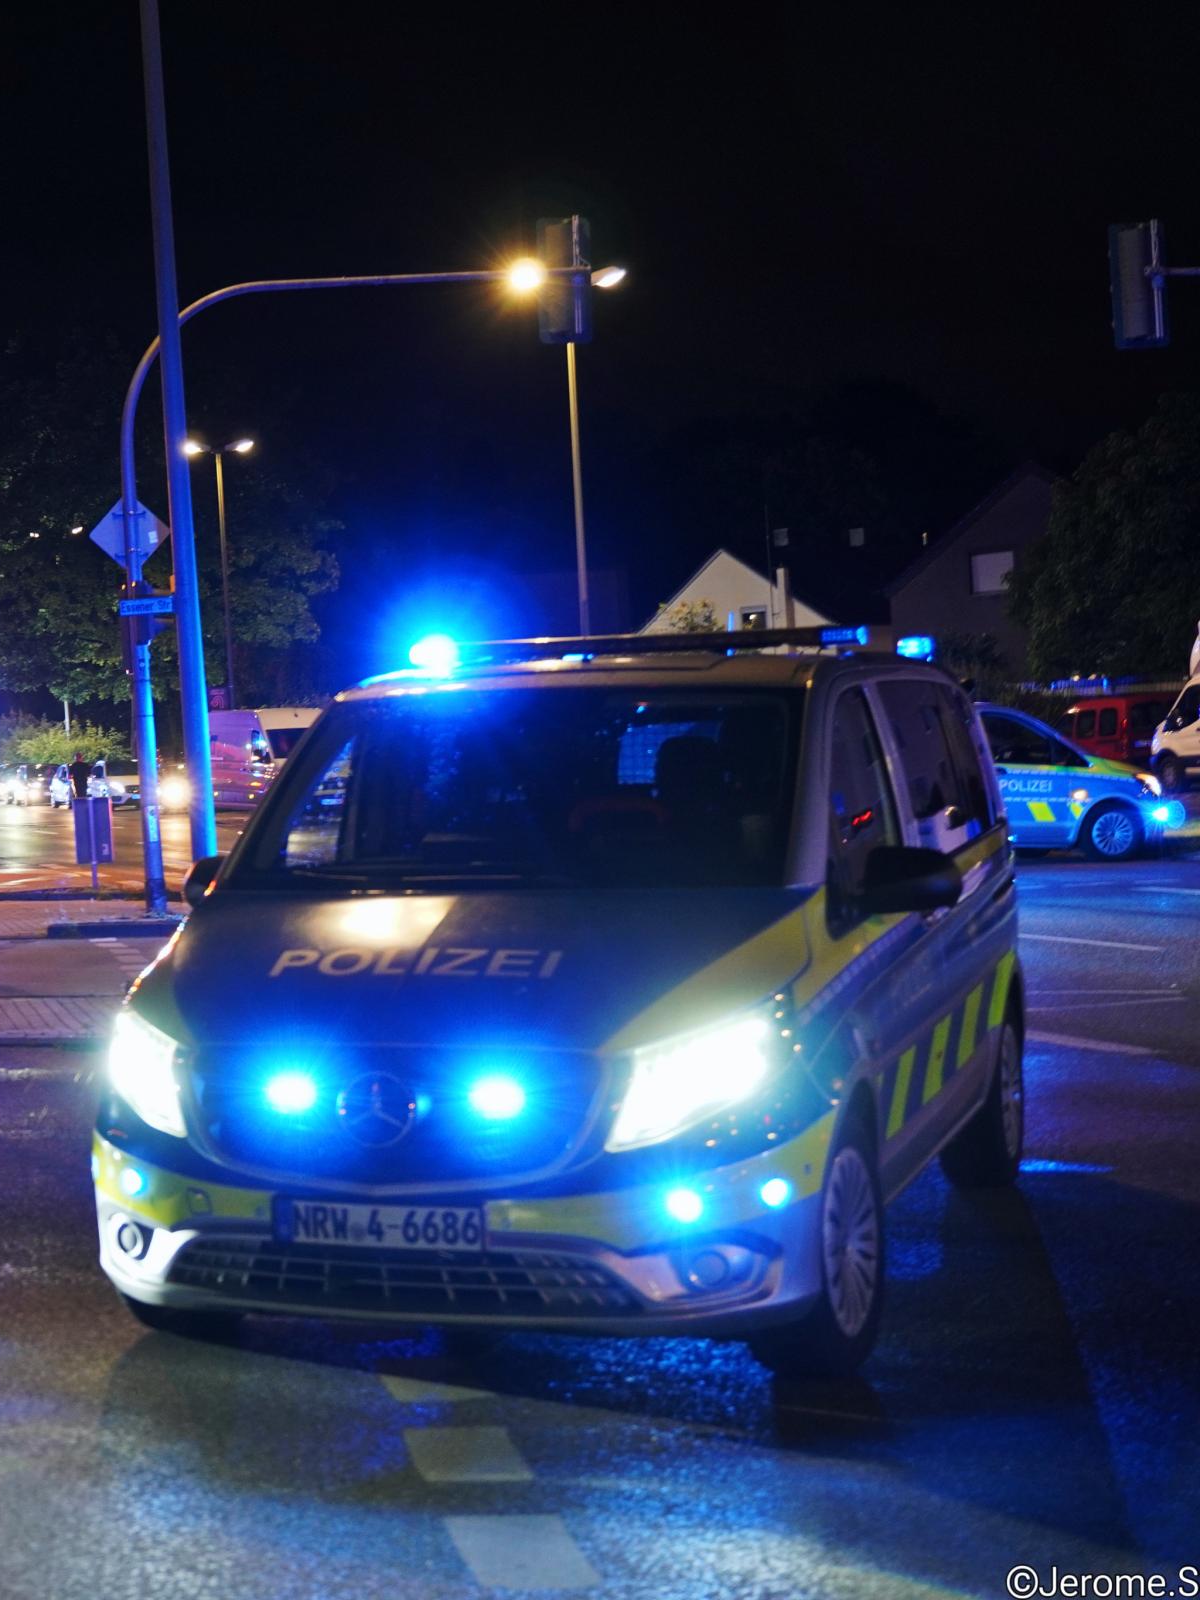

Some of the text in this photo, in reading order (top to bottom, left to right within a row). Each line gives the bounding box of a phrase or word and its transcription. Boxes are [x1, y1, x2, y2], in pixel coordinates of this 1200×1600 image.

[999, 779, 1052, 793] POLIZEI
[269, 948, 562, 978] POLIZEI
[294, 1205, 480, 1244] NRW 4-6686
